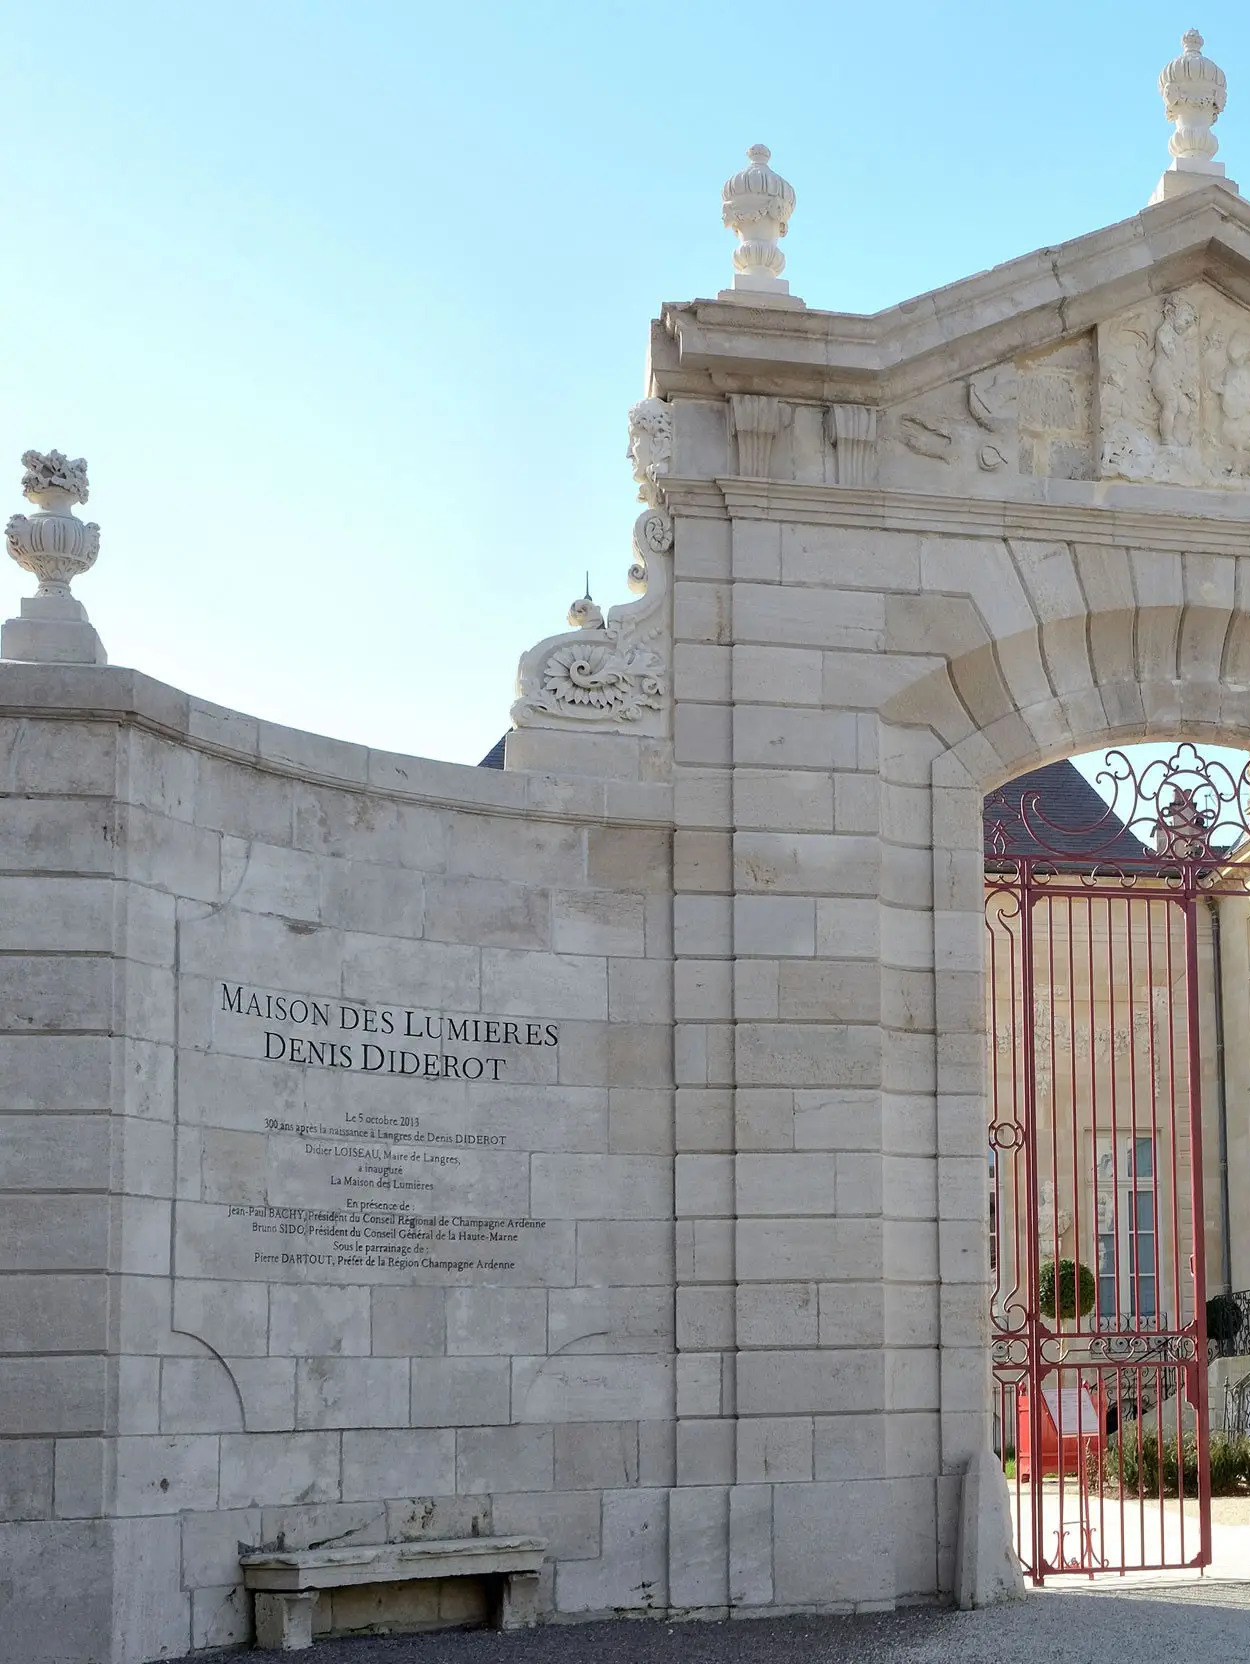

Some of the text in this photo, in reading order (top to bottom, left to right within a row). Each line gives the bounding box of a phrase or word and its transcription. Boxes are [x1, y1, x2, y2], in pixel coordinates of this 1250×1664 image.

[221, 984, 559, 1047] MAISON DES LUMIERES
[264, 1032, 506, 1081] DENIS DIDEROT
[346, 1113, 419, 1127] Le 5 octobre 2013
[265, 1118, 278, 1128] 300
[279, 1123, 294, 1131] ans
[319, 1124, 327, 1133] la
[329, 1128, 368, 1137] naissance
[377, 1130, 412, 1142] Langres
[414, 1132, 425, 1141] de
[427, 1133, 453, 1143] Denis
[455, 1134, 506, 1145] DIDEROT
[305, 1144, 332, 1154] Didier
[383, 1150, 408, 1161] Maire
[410, 1152, 420, 1161] de
[331, 1176, 341, 1185] La
[344, 1177, 374, 1187] Maison
[377, 1178, 391, 1188] des
[347, 1199, 358, 1208] En
[360, 1200, 398, 1212] présence
[400, 1201, 410, 1210] de
[228, 1205, 266, 1217] Jean-Paul
[350, 1213, 360, 1223] du
[362, 1215, 395, 1224] Conseil
[398, 1215, 437, 1228] Régional
[438, 1217, 449, 1226] de
[452, 1217, 505, 1229] Champagne
[508, 1218, 546, 1228] Ardenne
[252, 1222, 277, 1232] Bruno
[309, 1225, 348, 1237] Président
[350, 1227, 361, 1237] du
[364, 1229, 396, 1238] Conseil
[399, 1229, 433, 1240] Général
[436, 1230, 446, 1240] de
[448, 1231, 456, 1240] la
[458, 1231, 518, 1241] Haute-Marne
[333, 1241, 353, 1251] Sous
[356, 1241, 363, 1251] le
[365, 1242, 411, 1254] parrainage
[414, 1244, 424, 1253] de
[254, 1253, 279, 1263] Pierre
[365, 1256, 376, 1266] de
[378, 1257, 385, 1266] la
[388, 1258, 419, 1270] Région
[422, 1259, 474, 1272] Champagne
[476, 1259, 515, 1269] Ardenne
